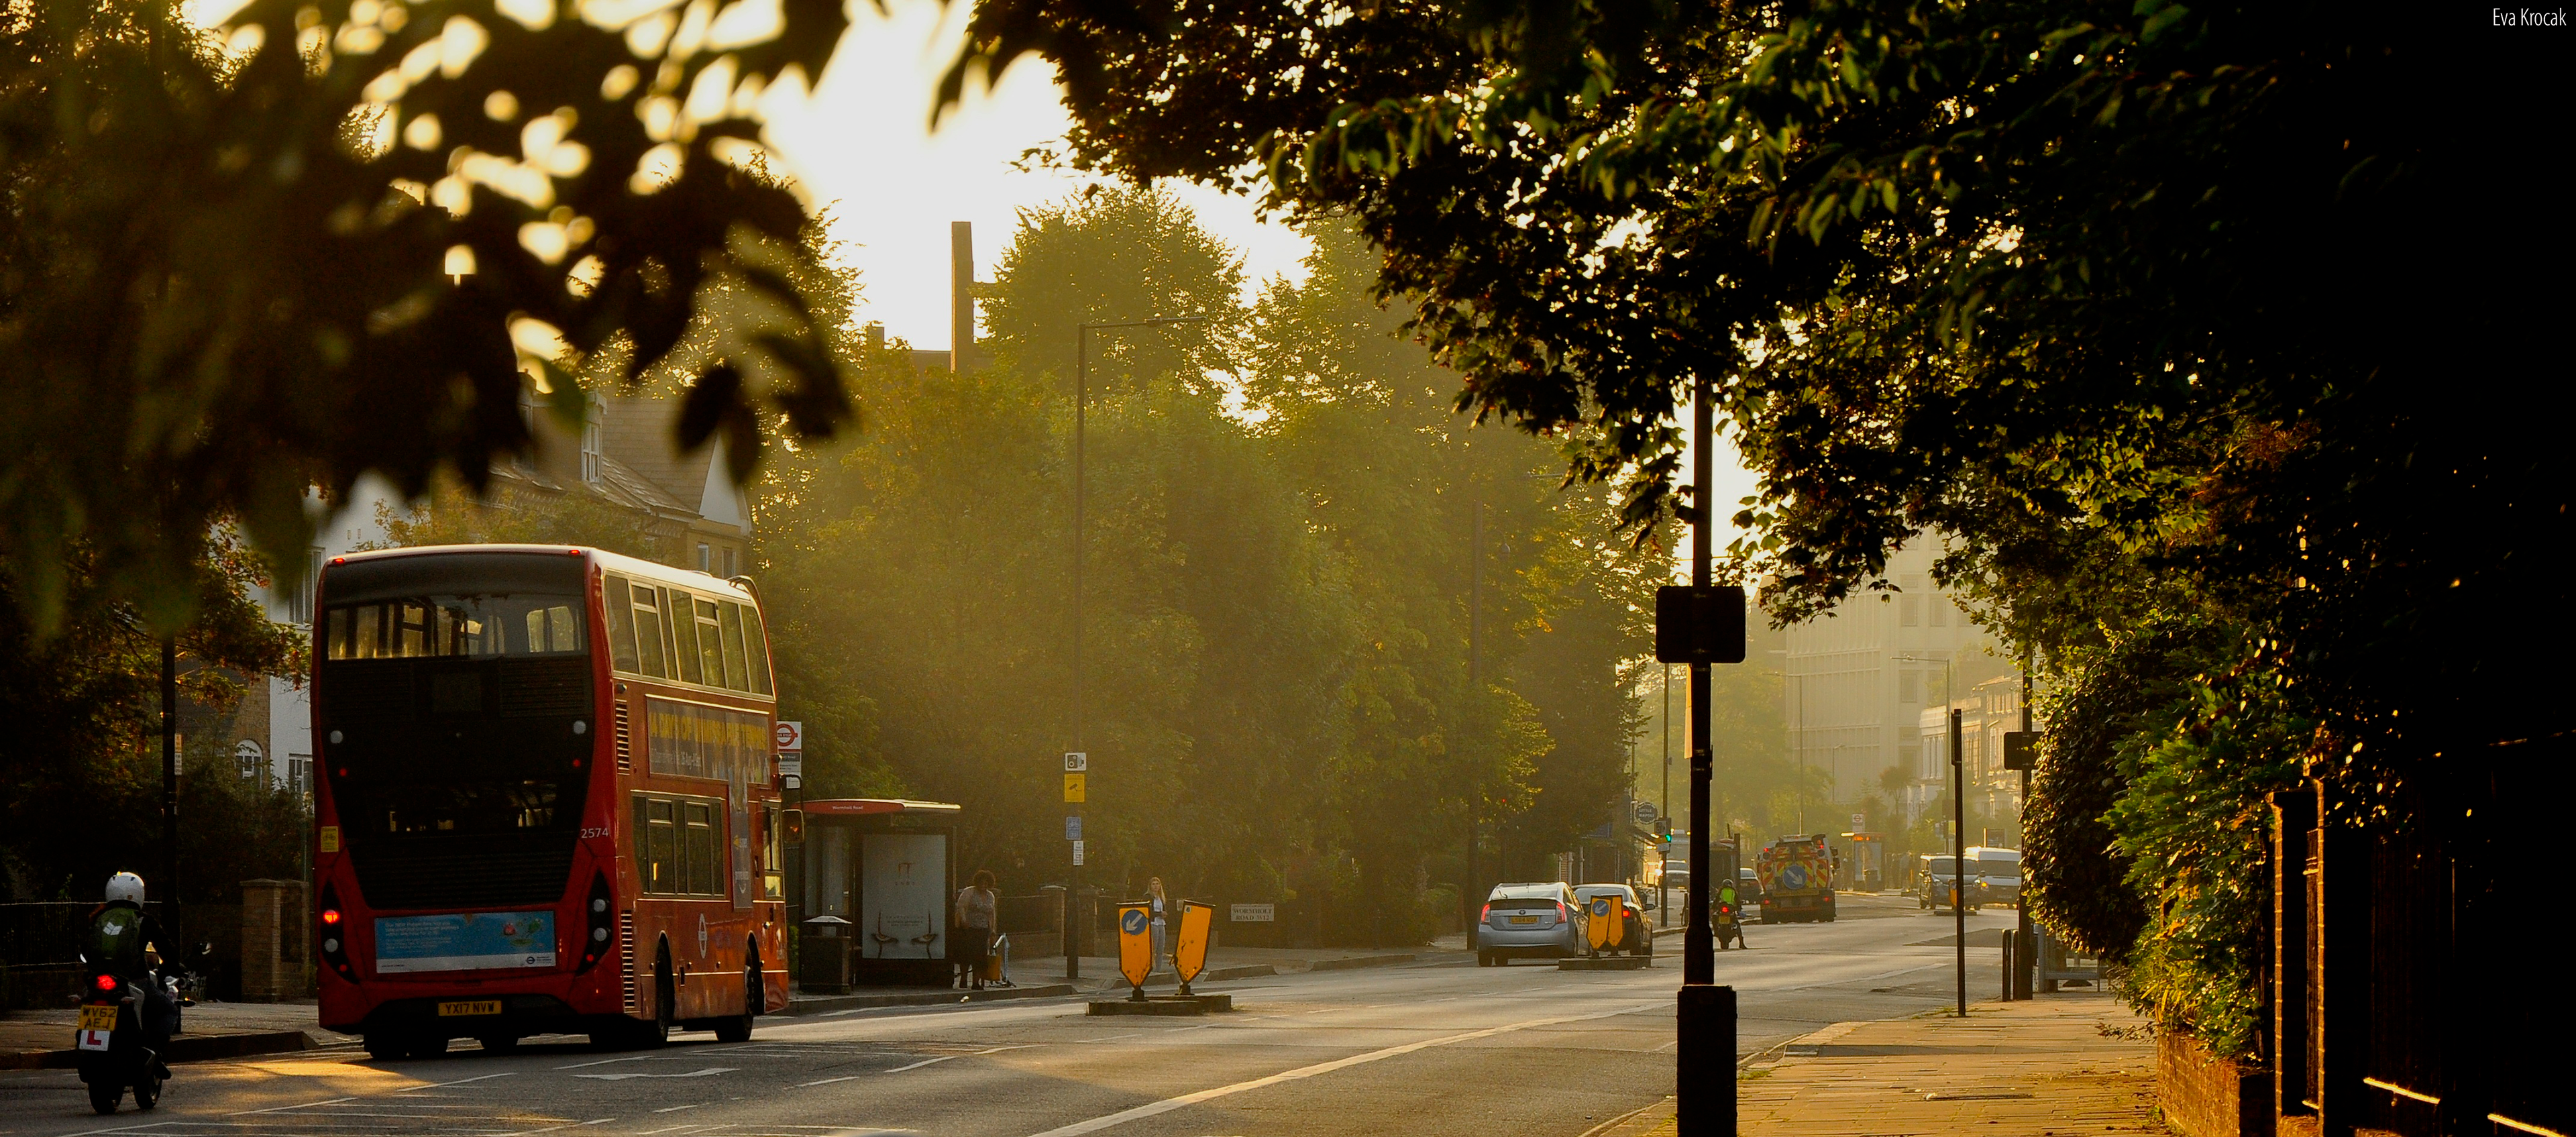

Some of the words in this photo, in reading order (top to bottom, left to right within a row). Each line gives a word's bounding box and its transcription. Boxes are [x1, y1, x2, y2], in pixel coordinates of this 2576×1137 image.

[581, 828, 608, 838] 2574
[83, 1007, 116, 1018] WV62
[445, 1003, 470, 1014] YX17
[473, 1001, 494, 1013] NVW
[85, 1018, 110, 1029] AEJ
[87, 1030, 102, 1046] L
